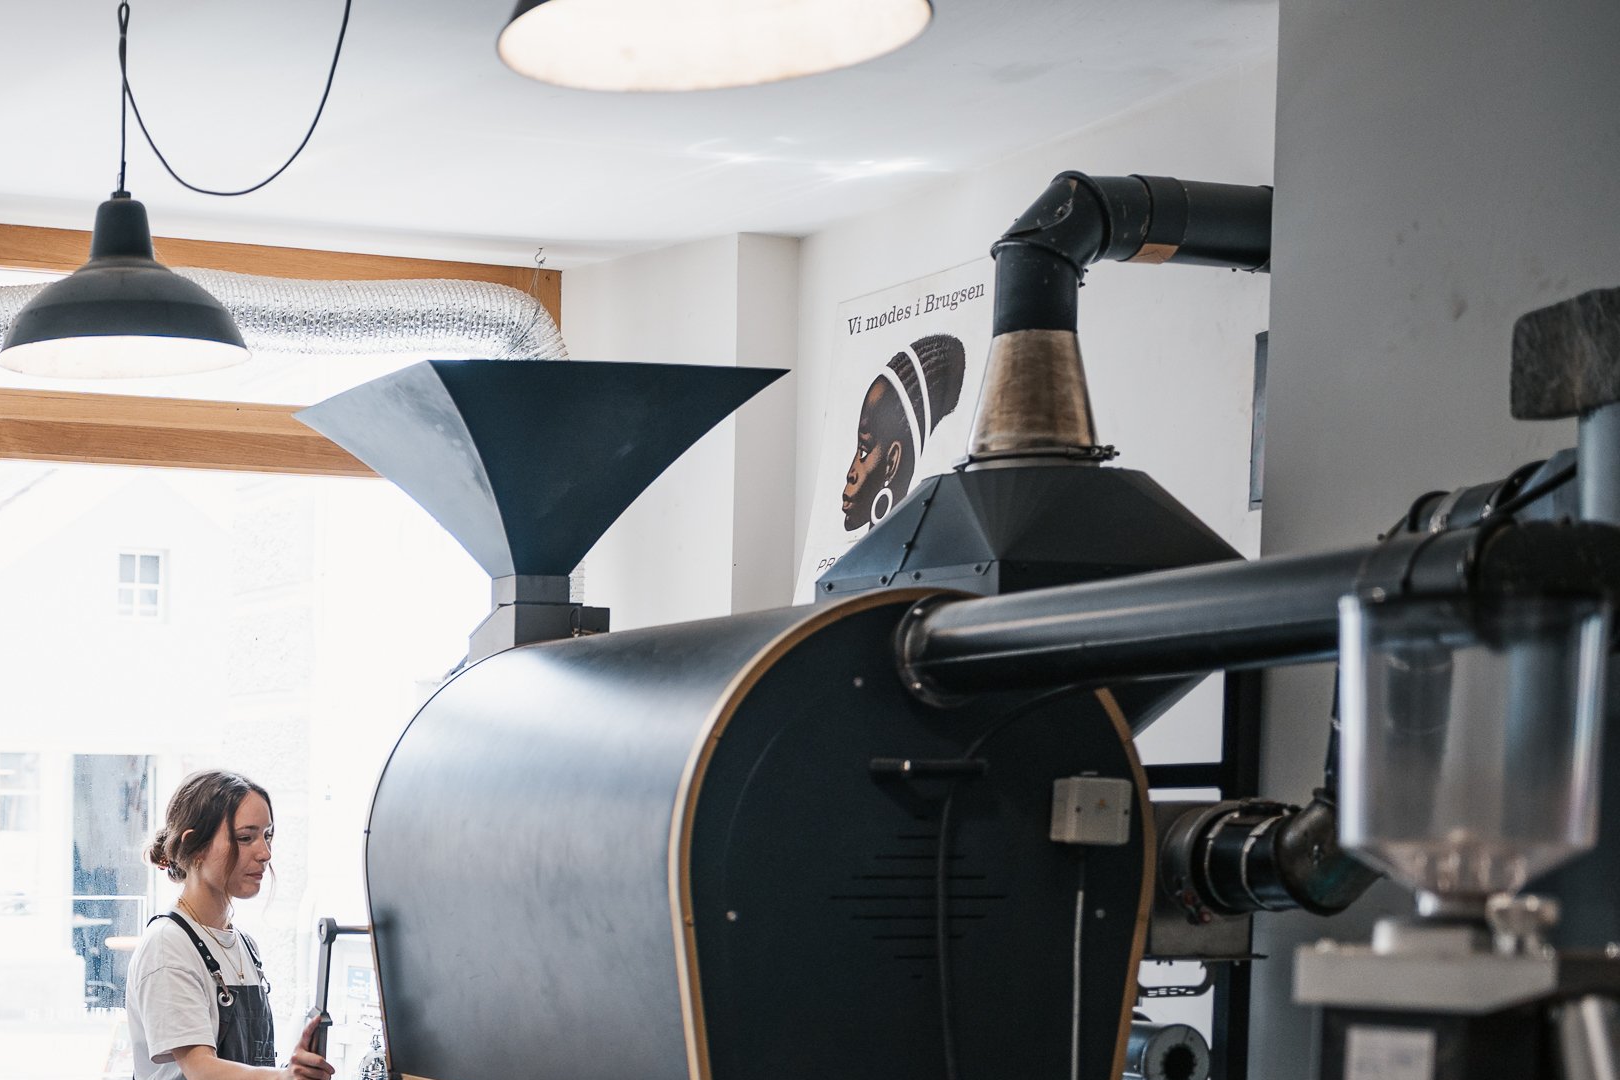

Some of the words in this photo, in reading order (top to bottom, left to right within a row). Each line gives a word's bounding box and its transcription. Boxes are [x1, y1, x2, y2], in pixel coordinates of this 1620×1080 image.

[847, 316, 862, 335] Vi
[865, 305, 912, 331] mødes
[914, 297, 921, 316] i
[923, 283, 985, 311] Brugsen
[816, 555, 845, 573] PR
